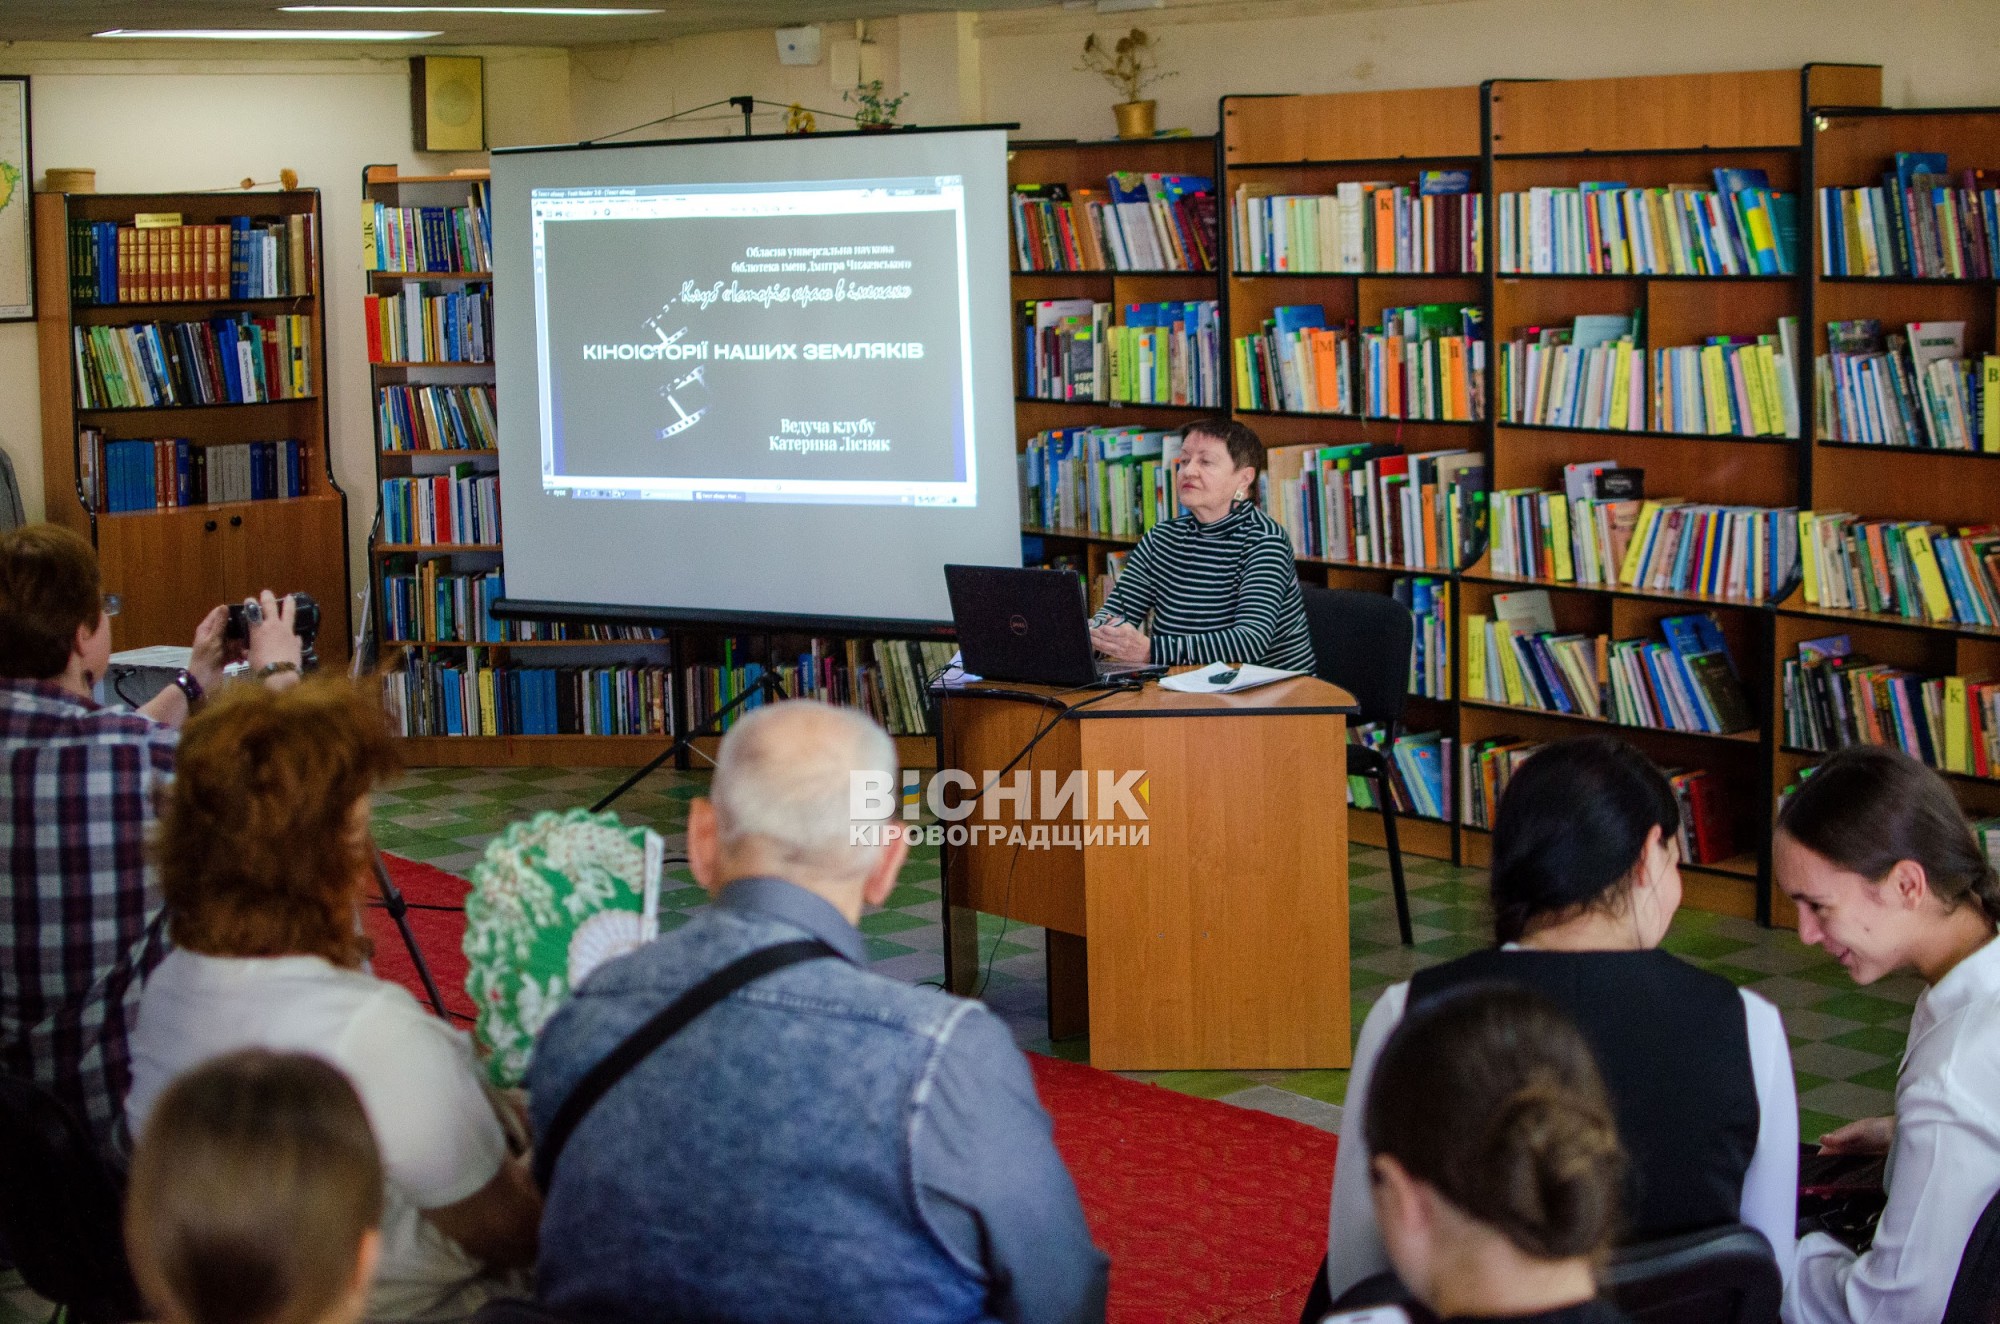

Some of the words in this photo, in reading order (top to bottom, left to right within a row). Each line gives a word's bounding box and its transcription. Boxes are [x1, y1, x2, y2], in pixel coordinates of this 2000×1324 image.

[363, 221, 375, 250] УДК
[746, 246, 786, 258] Обласна
[788, 246, 853, 259] універсальна
[854, 245, 895, 257] наукова
[731, 261, 780, 273] бібліотека
[781, 261, 806, 272] імені
[807, 260, 845, 274] Дмитра
[846, 260, 912, 271] Чижевського
[679, 279, 724, 310] Клуб
[583, 341, 708, 360] КІНОІСТОРІЇ
[714, 343, 797, 360] НАШИХ
[803, 342, 924, 360] ЗЕМЛЯКІВ
[781, 418, 830, 437] Ведуча
[833, 418, 876, 437] клубу
[769, 436, 837, 455] Катерина
